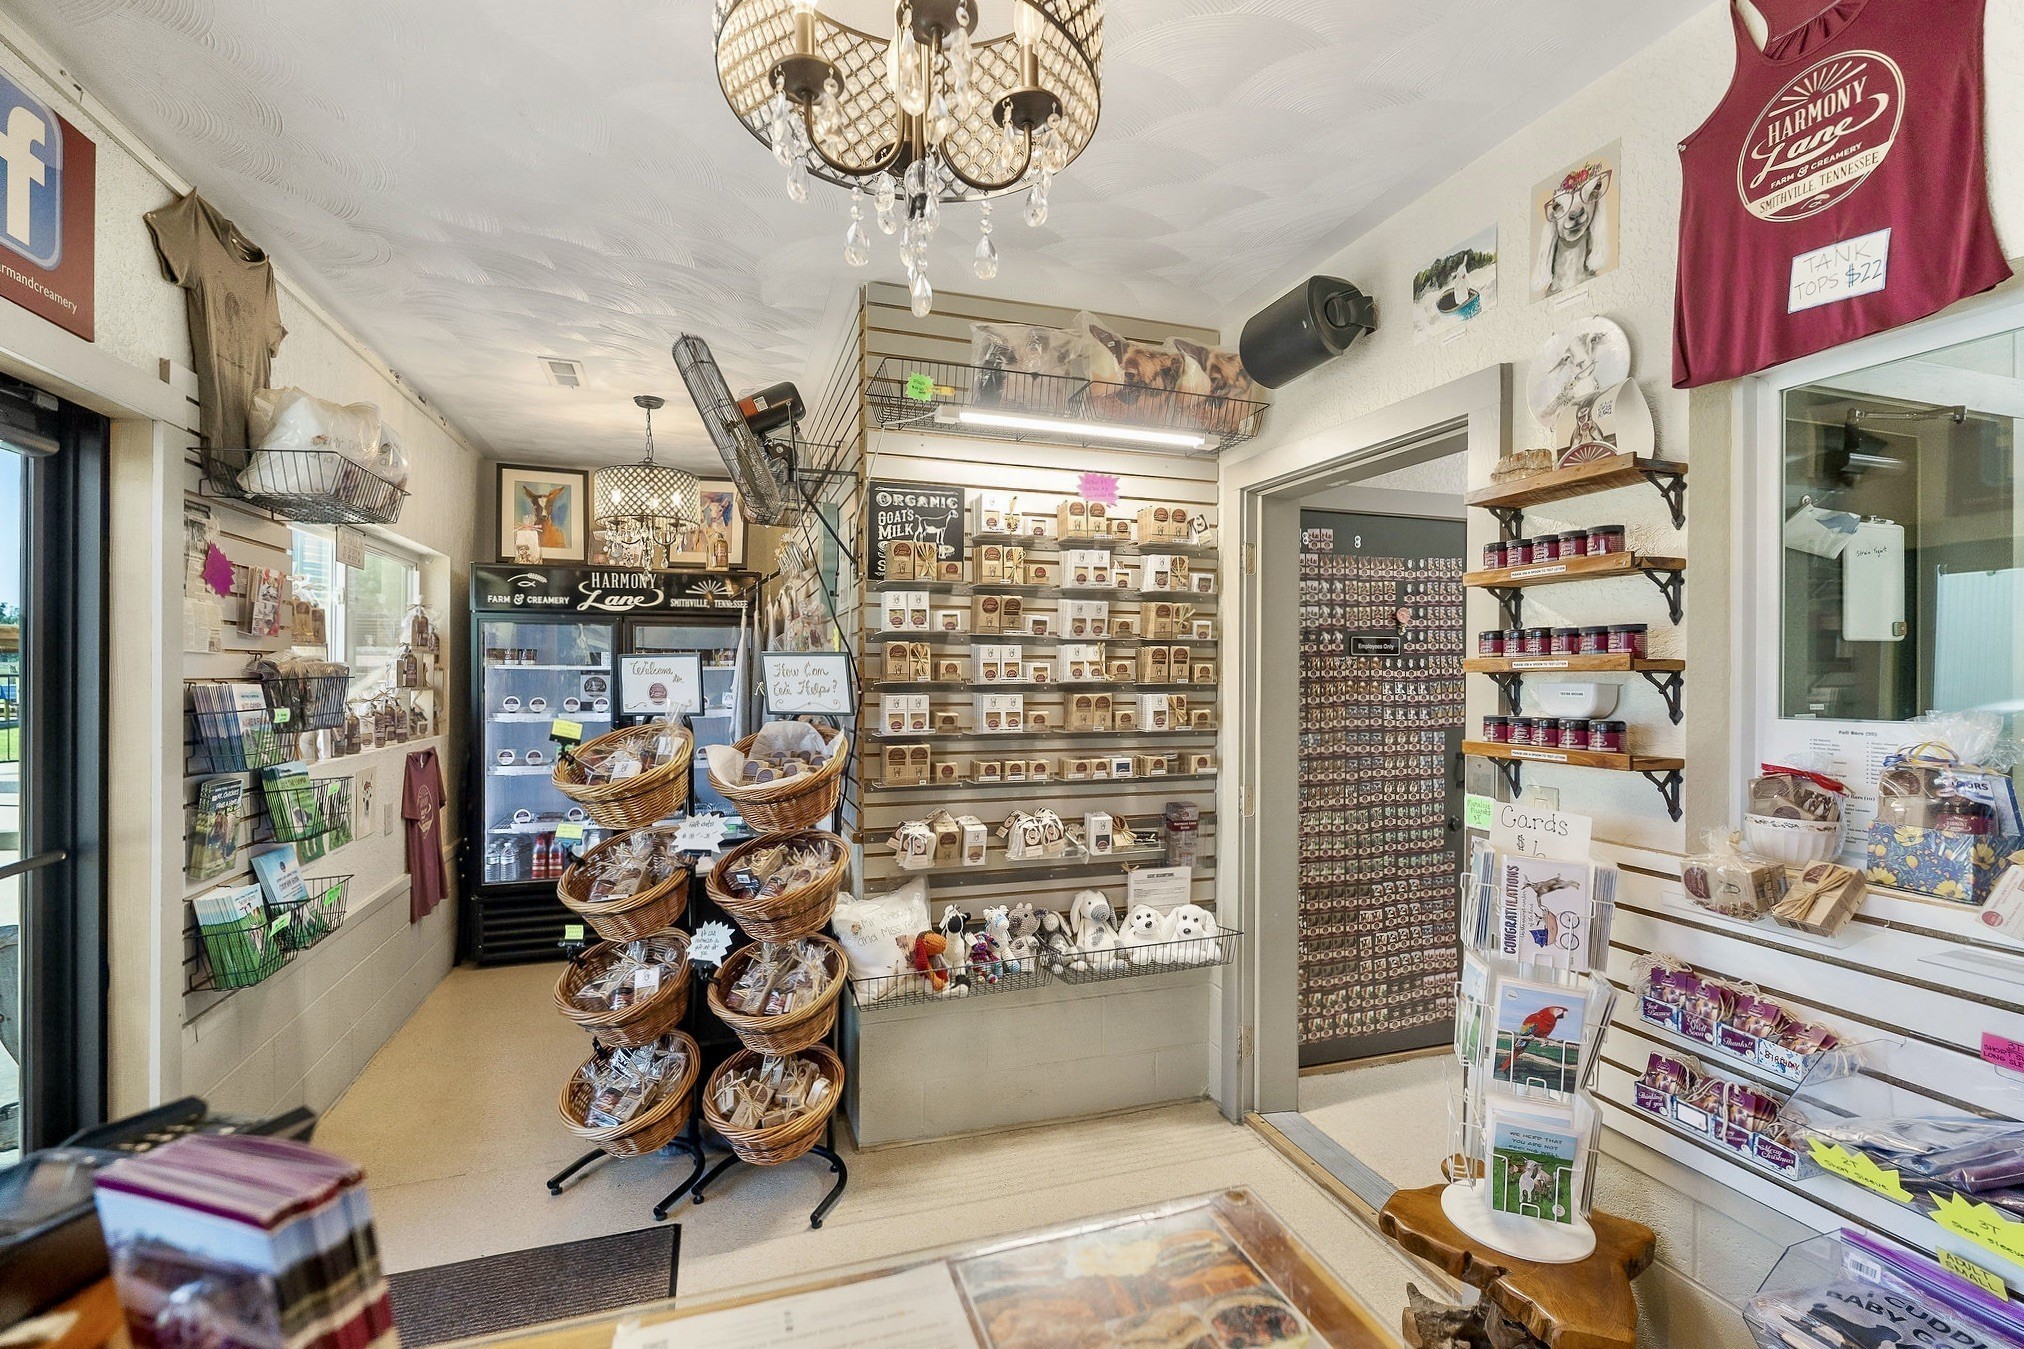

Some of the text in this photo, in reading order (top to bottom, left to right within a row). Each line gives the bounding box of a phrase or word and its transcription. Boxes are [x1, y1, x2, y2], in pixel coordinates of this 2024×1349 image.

[1767, 76, 1869, 147] HARMONY
[1750, 92, 1890, 189] Lane
[1770, 142, 1863, 189] FARM & CREAMERY
[1819, 151, 1880, 185] TENNESSEE
[1803, 241, 1871, 274] TANK
[1794, 259, 1883, 300] TOPS $22
[0, 264, 77, 315] rmandcreamery
[875, 491, 958, 509] ORGANIC
[877, 507, 914, 526] GOAT'S
[877, 523, 914, 540] MILK
[591, 572, 657, 589] HARMONY
[487, 593, 570, 605] FARM & CREAMERY
[576, 581, 664, 611] Lane
[714, 599, 748, 609] TENNESSEE
[1358, 643, 1395, 651] Employees Only
[630, 660, 674, 676] Welcome
[772, 661, 829, 678] How Can
[773, 681, 792, 696] We
[1501, 805, 1568, 836] Cards
[1503, 864, 1520, 955] CONGRATULATIONS
[1544, 1137, 1563, 1145] THAT
[1760, 1144, 1783, 1156] Merry
[1761, 1151, 1794, 1164] Christmas
[1979, 1219, 2001, 1235] 3T
[1946, 1252, 1990, 1280] ADULT
[1945, 1260, 2000, 1293] SMALL
[1826, 1290, 1907, 1324] BABY
